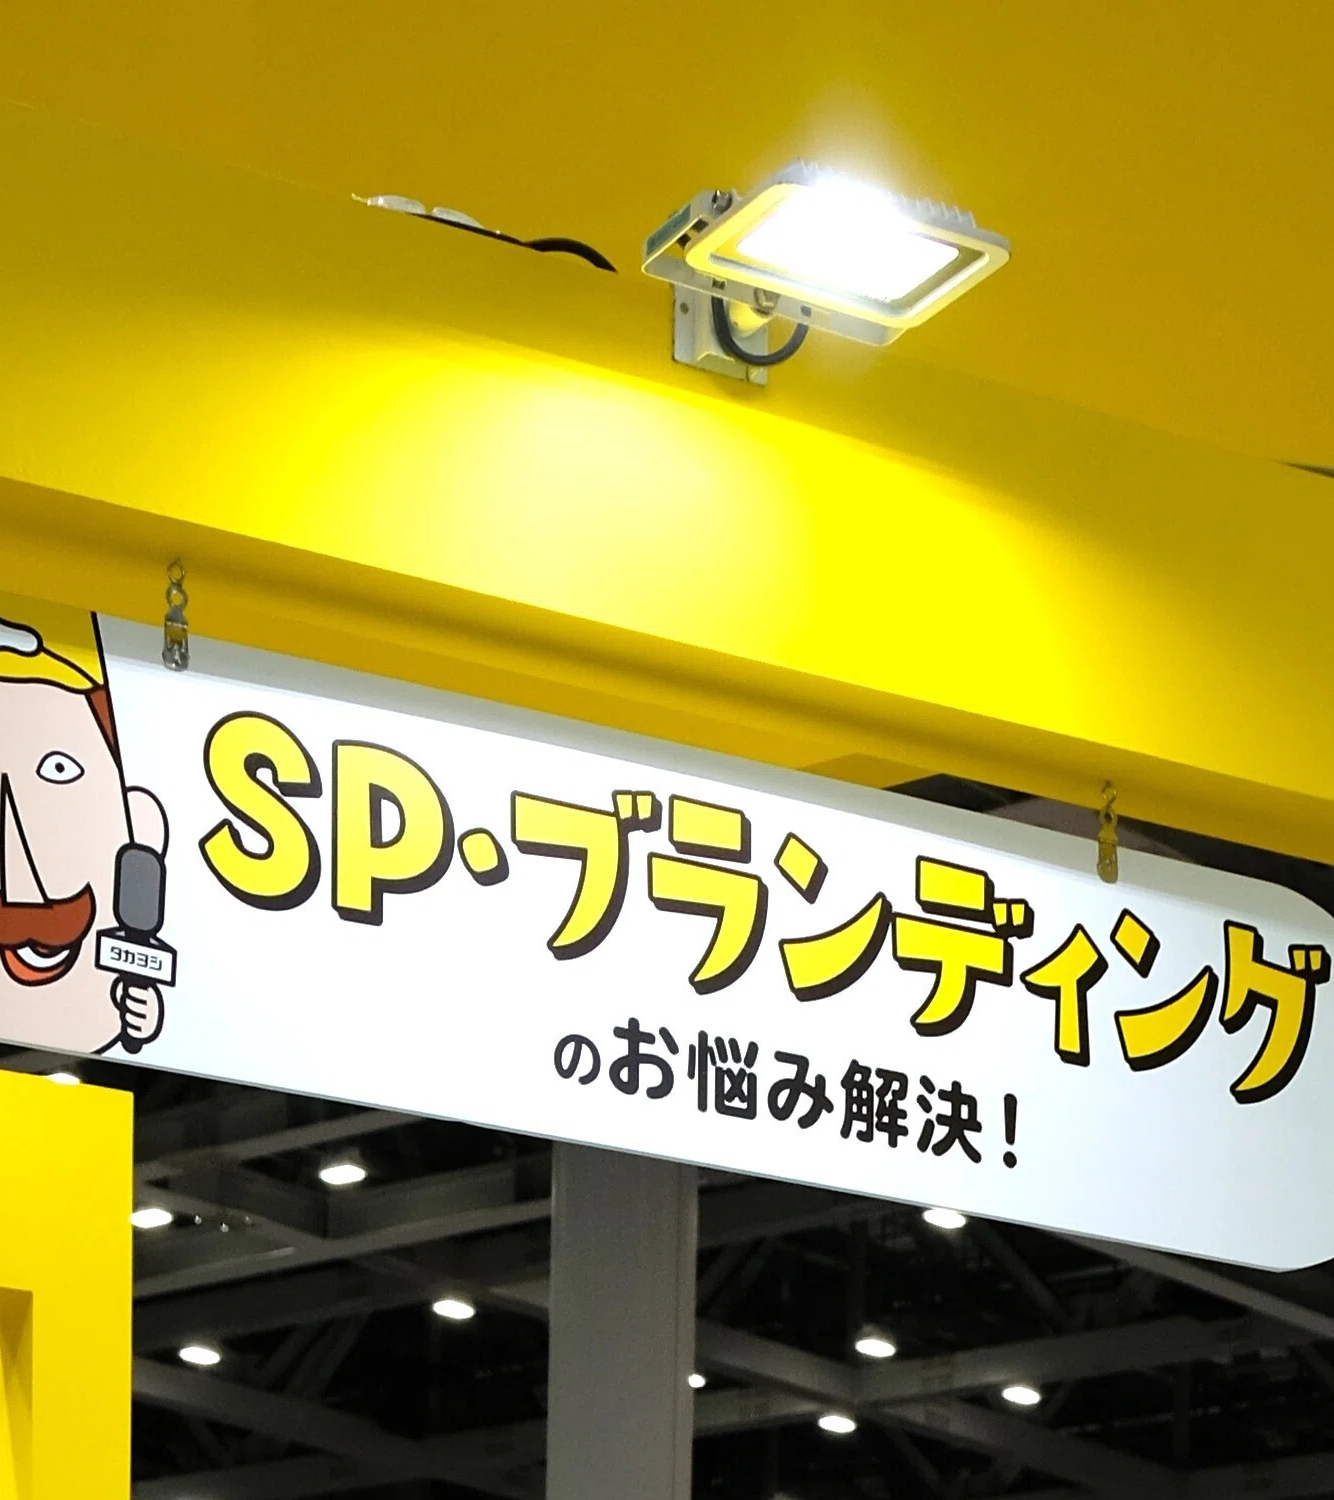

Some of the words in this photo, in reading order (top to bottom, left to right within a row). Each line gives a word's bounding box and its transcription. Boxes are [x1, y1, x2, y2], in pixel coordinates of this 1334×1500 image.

[200, 710, 1331, 1105] SP・ブランディング
[554, 1018, 1024, 1168] のお悩み解決!
